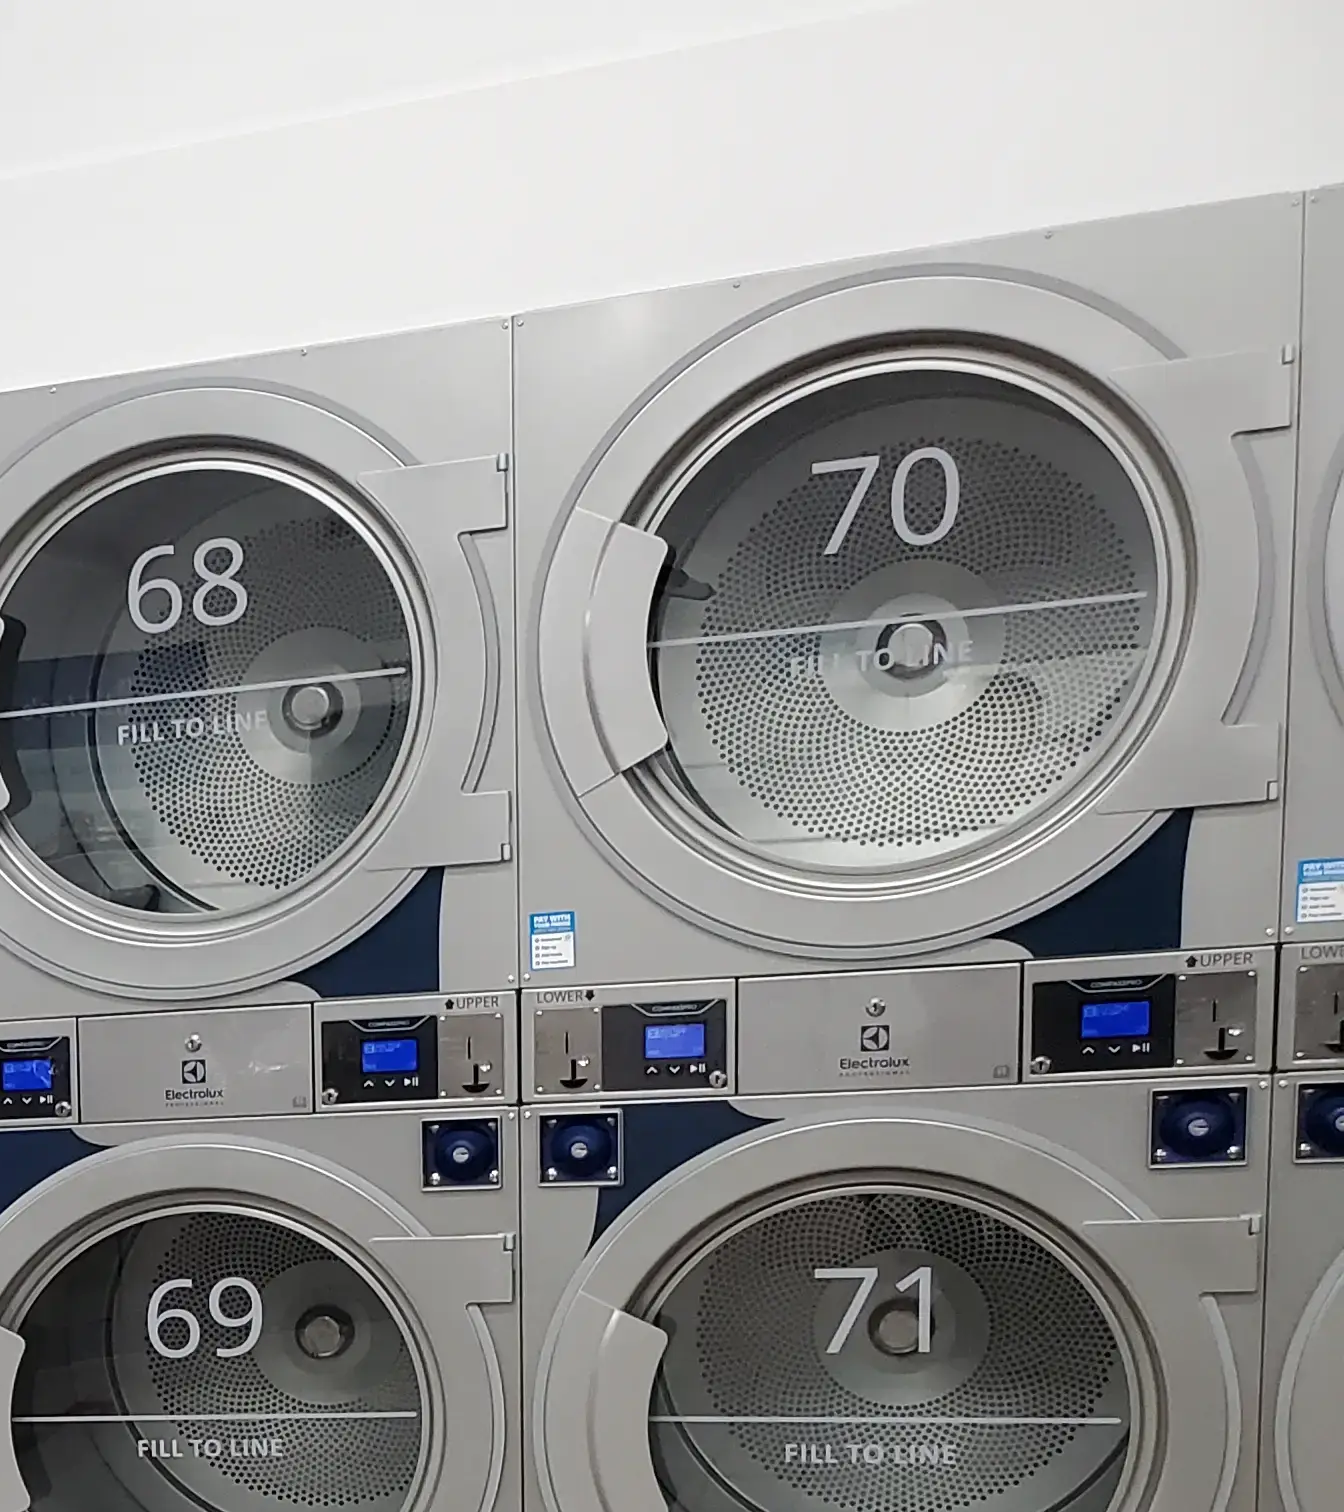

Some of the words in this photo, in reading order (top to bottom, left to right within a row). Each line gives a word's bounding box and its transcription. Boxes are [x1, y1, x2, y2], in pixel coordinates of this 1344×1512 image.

[811, 446, 960, 555] 70
[128, 537, 248, 634] 68
[855, 648, 894, 672] TO
[117, 721, 164, 746] FILL
[171, 717, 204, 739] TO
[212, 710, 267, 735] LINE
[1200, 951, 1253, 967] UPPER
[456, 995, 499, 1010] UPPER
[536, 990, 583, 1004] LOWER
[839, 1056, 911, 1071] Electrolux
[165, 1087, 224, 1101] Electrolux
[147, 1276, 263, 1359] 69
[814, 1266, 932, 1354] 71
[137, 1439, 183, 1458] FILL
[188, 1439, 222, 1458] TO
[230, 1439, 283, 1458] LINE
[784, 1444, 838, 1464] FILL
[845, 1444, 880, 1465] TO
[895, 1445, 957, 1465] LINE
